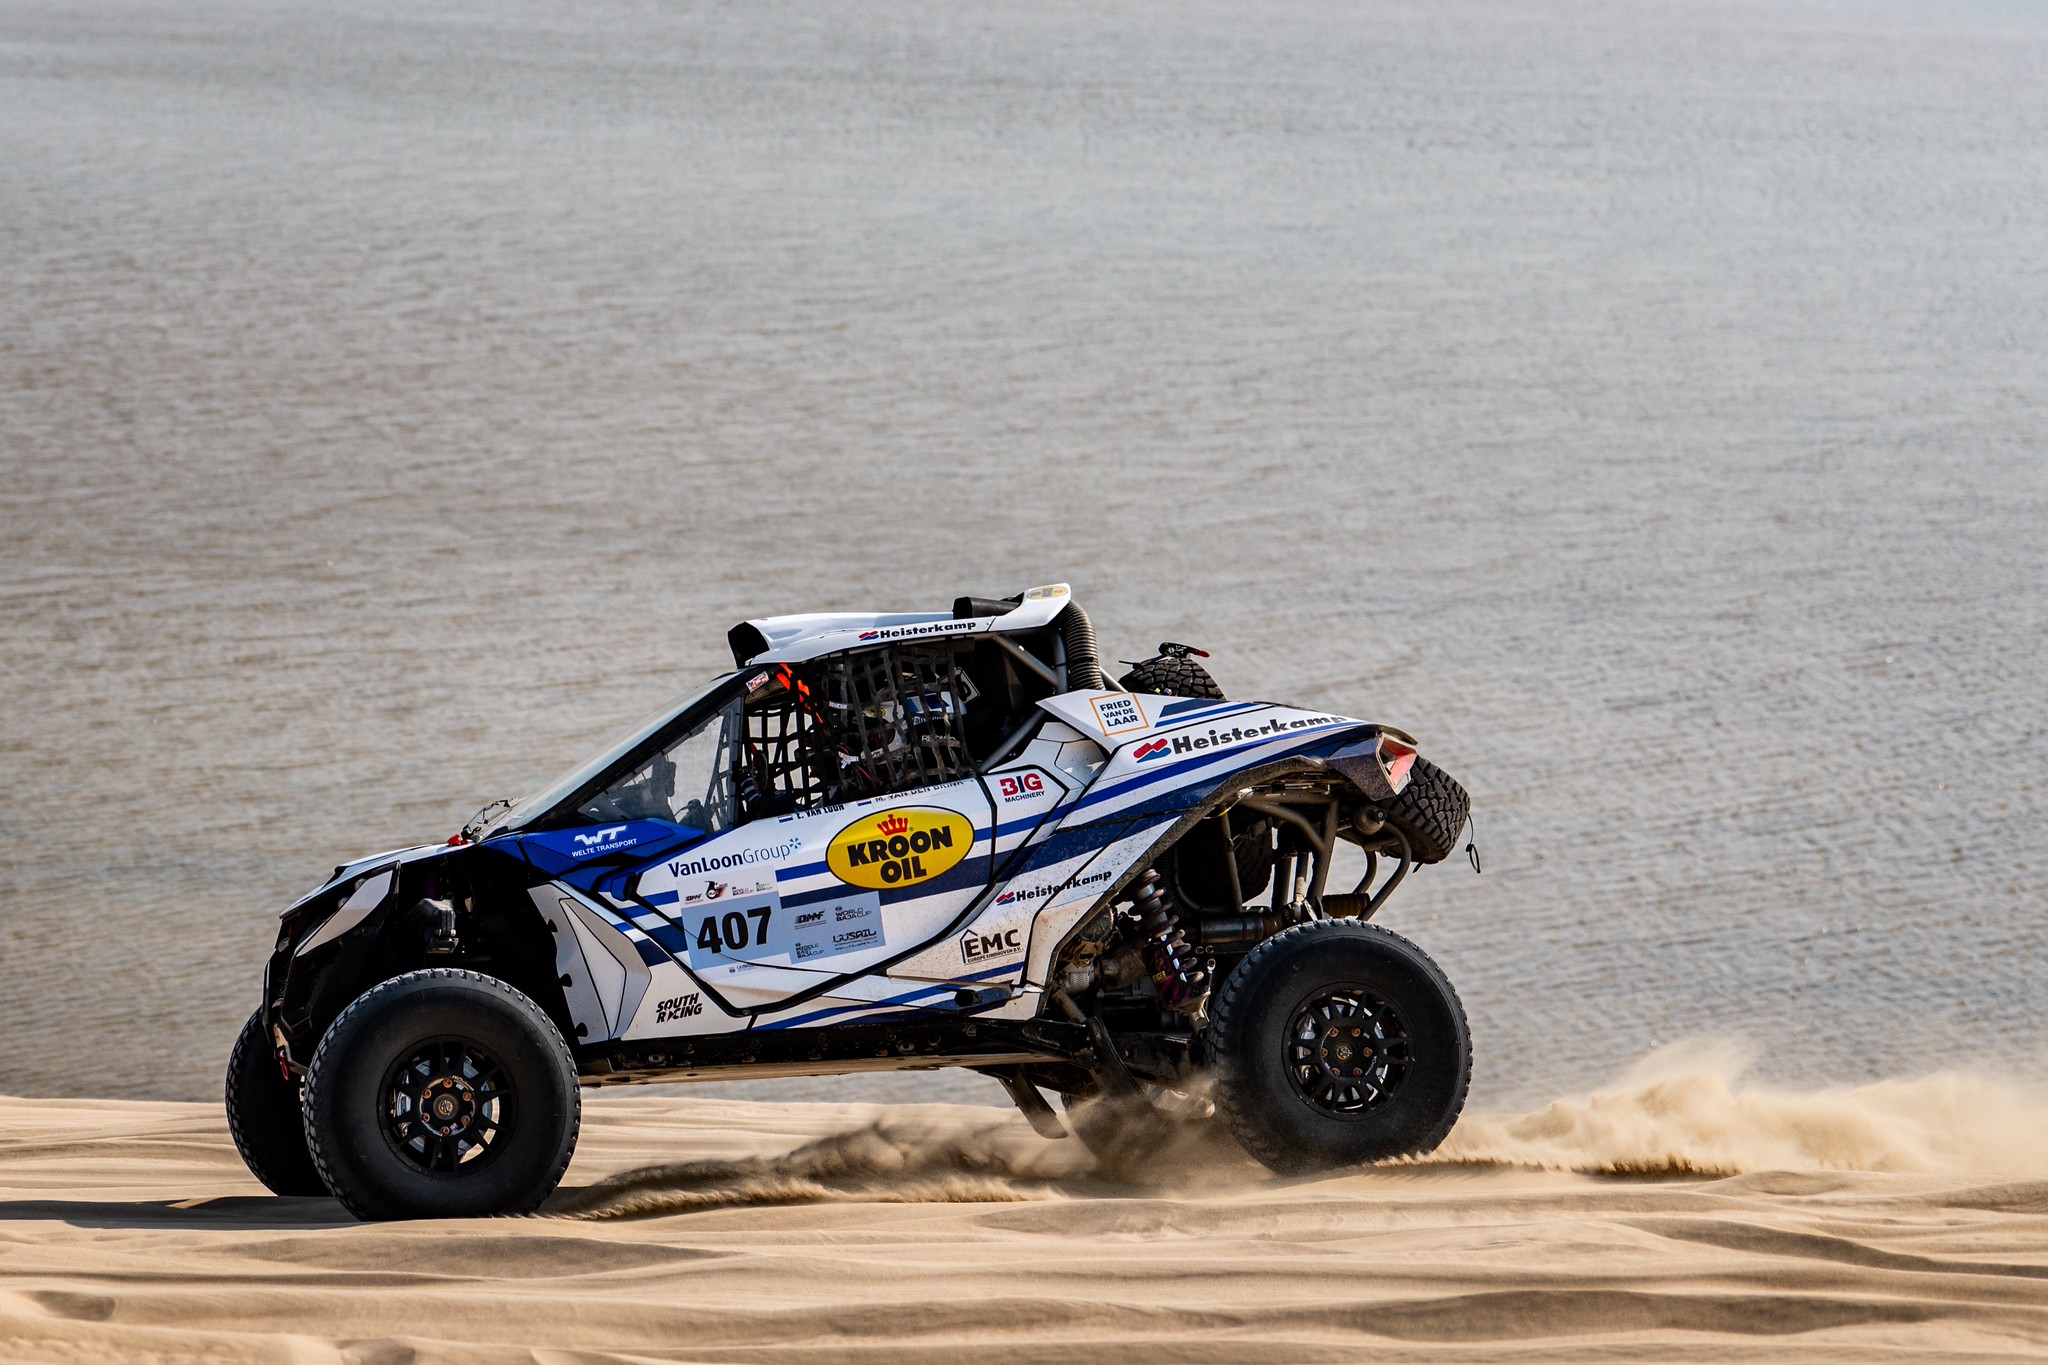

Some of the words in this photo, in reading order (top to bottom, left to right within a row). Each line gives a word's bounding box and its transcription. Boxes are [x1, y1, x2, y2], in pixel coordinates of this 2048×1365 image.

[880, 621, 976, 639] Heisterkamp
[1099, 699, 1132, 712] FRIED
[1103, 710, 1122, 719] VAN
[1122, 707, 1135, 715] DE
[1106, 714, 1139, 727] LAAR
[1171, 716, 1347, 754] Heisterkamp
[1000, 773, 1044, 797] BIG
[1004, 790, 1045, 803] MACHINERY
[573, 825, 628, 846] WT
[847, 825, 953, 867] KROON
[571, 846, 596, 858] WELTE
[596, 838, 638, 852] TRANSPORT
[668, 844, 791, 878] VanLoonGroup
[880, 856, 928, 884] OIL
[835, 907, 864, 917] WORLD
[836, 913, 857, 922] BAJA
[857, 910, 872, 918] CUP
[697, 905, 772, 954] 407
[964, 929, 1021, 958] EMC
[656, 992, 699, 1013] SOUTH
